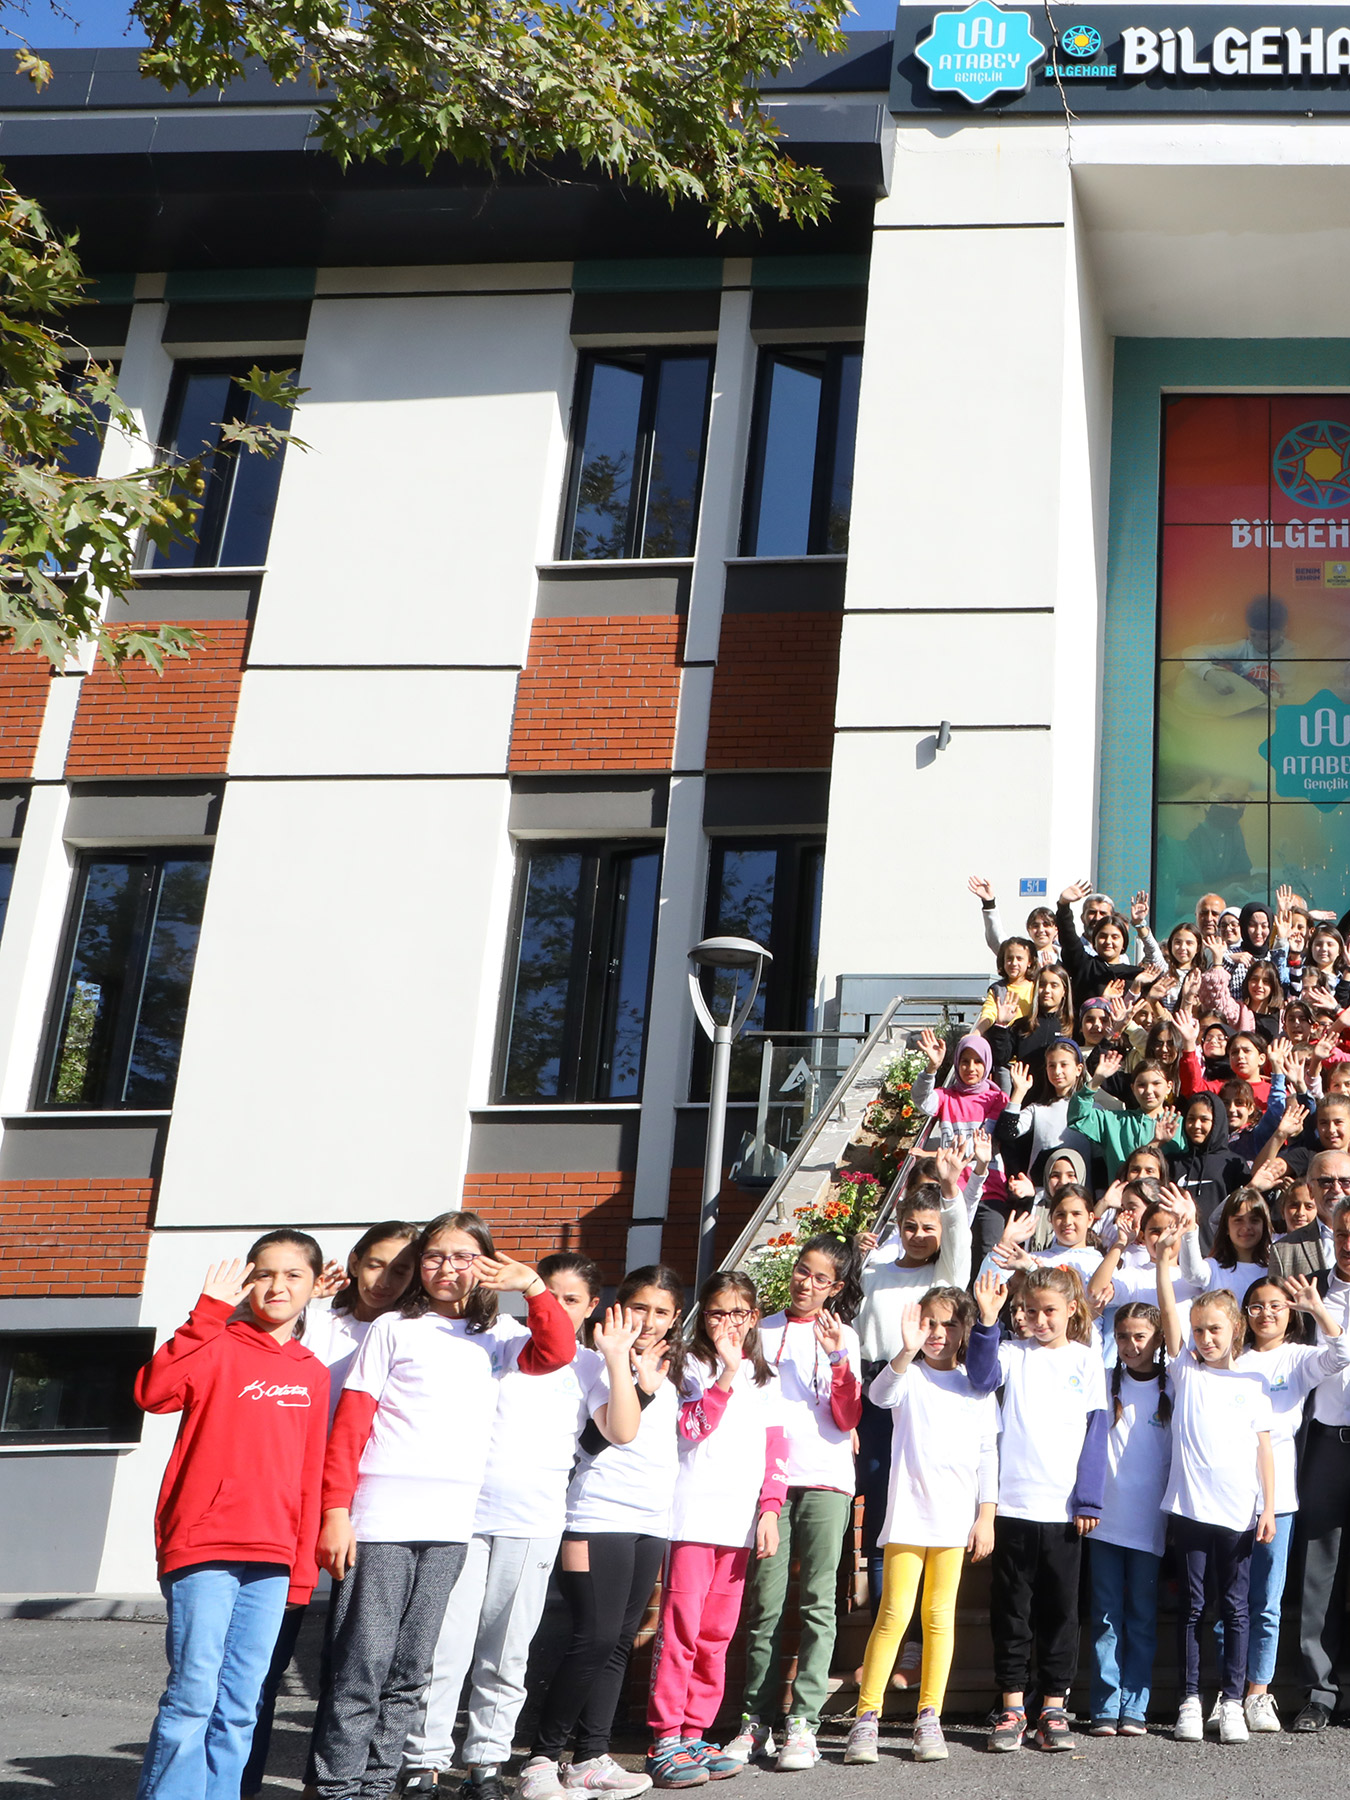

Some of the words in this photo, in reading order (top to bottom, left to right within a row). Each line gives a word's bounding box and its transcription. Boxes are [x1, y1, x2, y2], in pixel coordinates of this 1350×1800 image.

[939, 53, 1021, 70] ATABEY
[1303, 777, 1349, 792] Gençlik
[1026, 880, 1040, 893] 5/1
